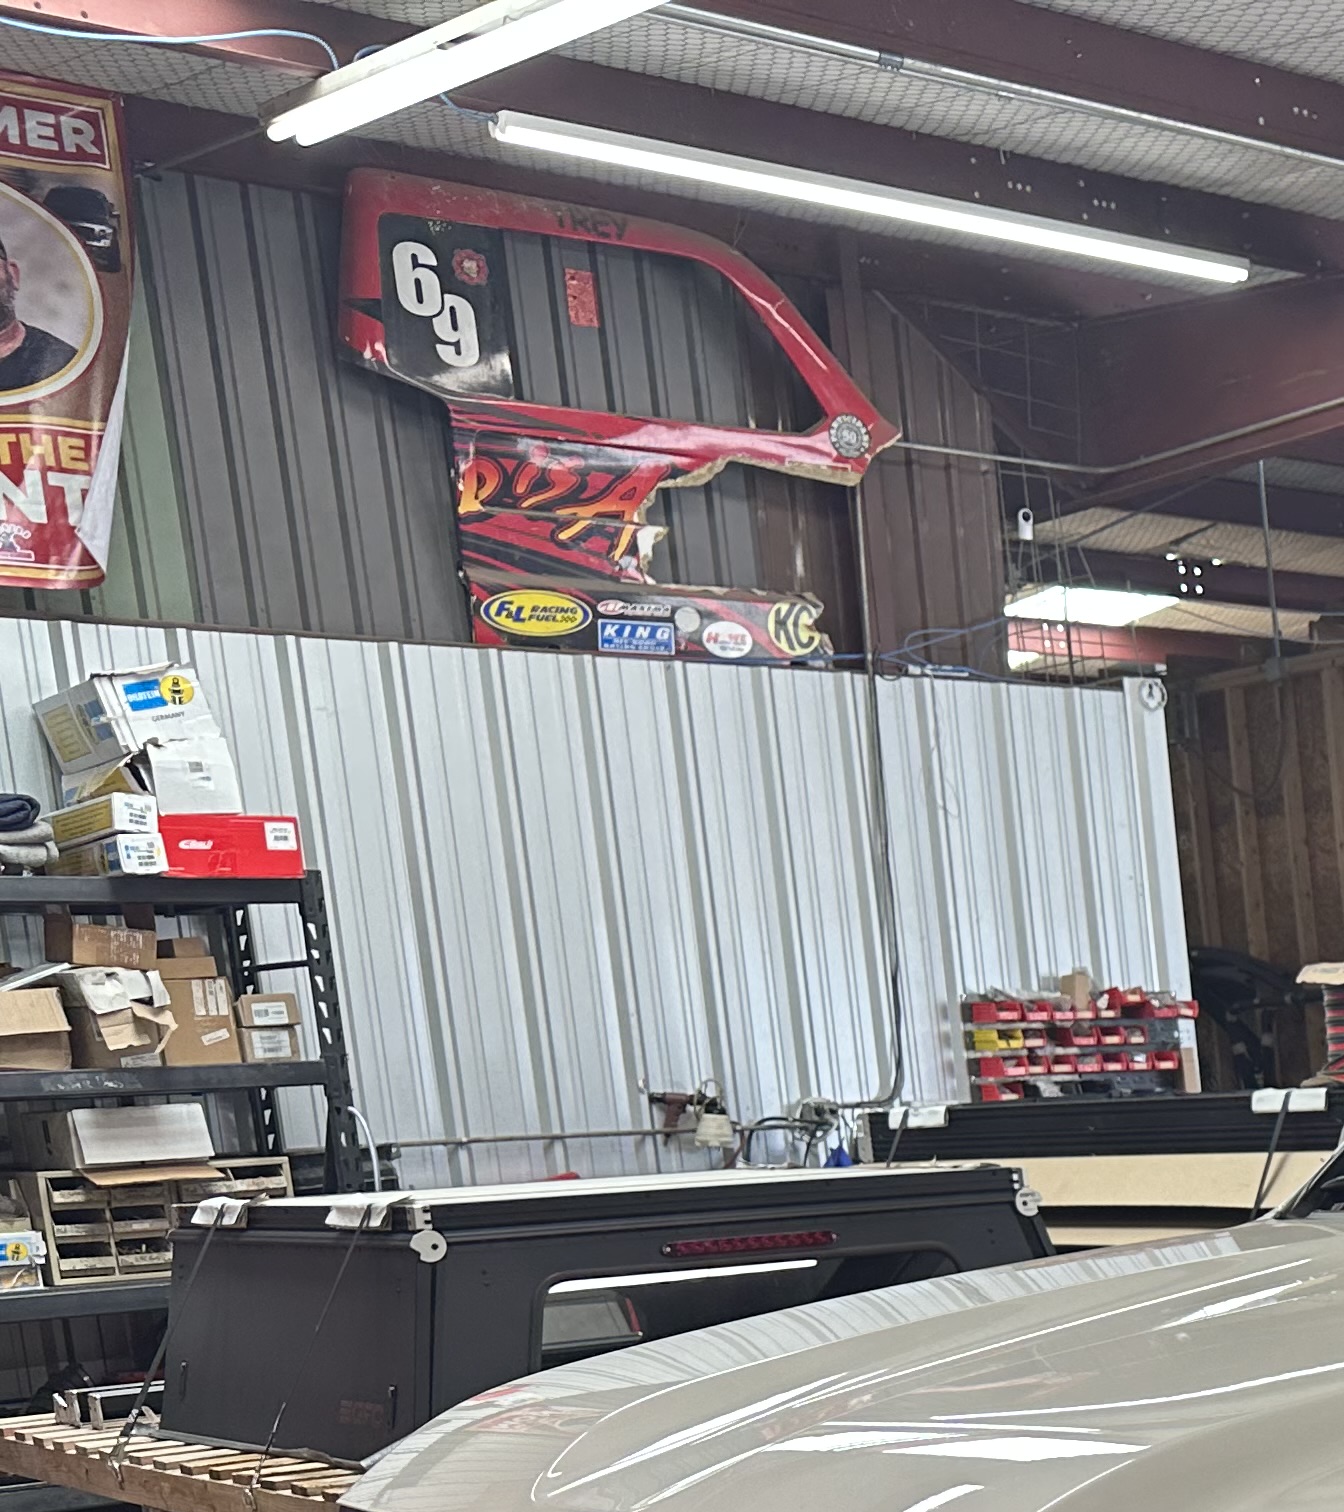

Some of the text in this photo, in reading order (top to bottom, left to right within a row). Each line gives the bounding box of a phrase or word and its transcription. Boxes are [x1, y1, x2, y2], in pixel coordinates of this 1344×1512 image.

[0, 433, 90, 471] THE
[527, 614, 559, 623] FUEL
[530, 605, 578, 615] RACING
[603, 623, 671, 641] KING
[774, 602, 816, 653] KC
